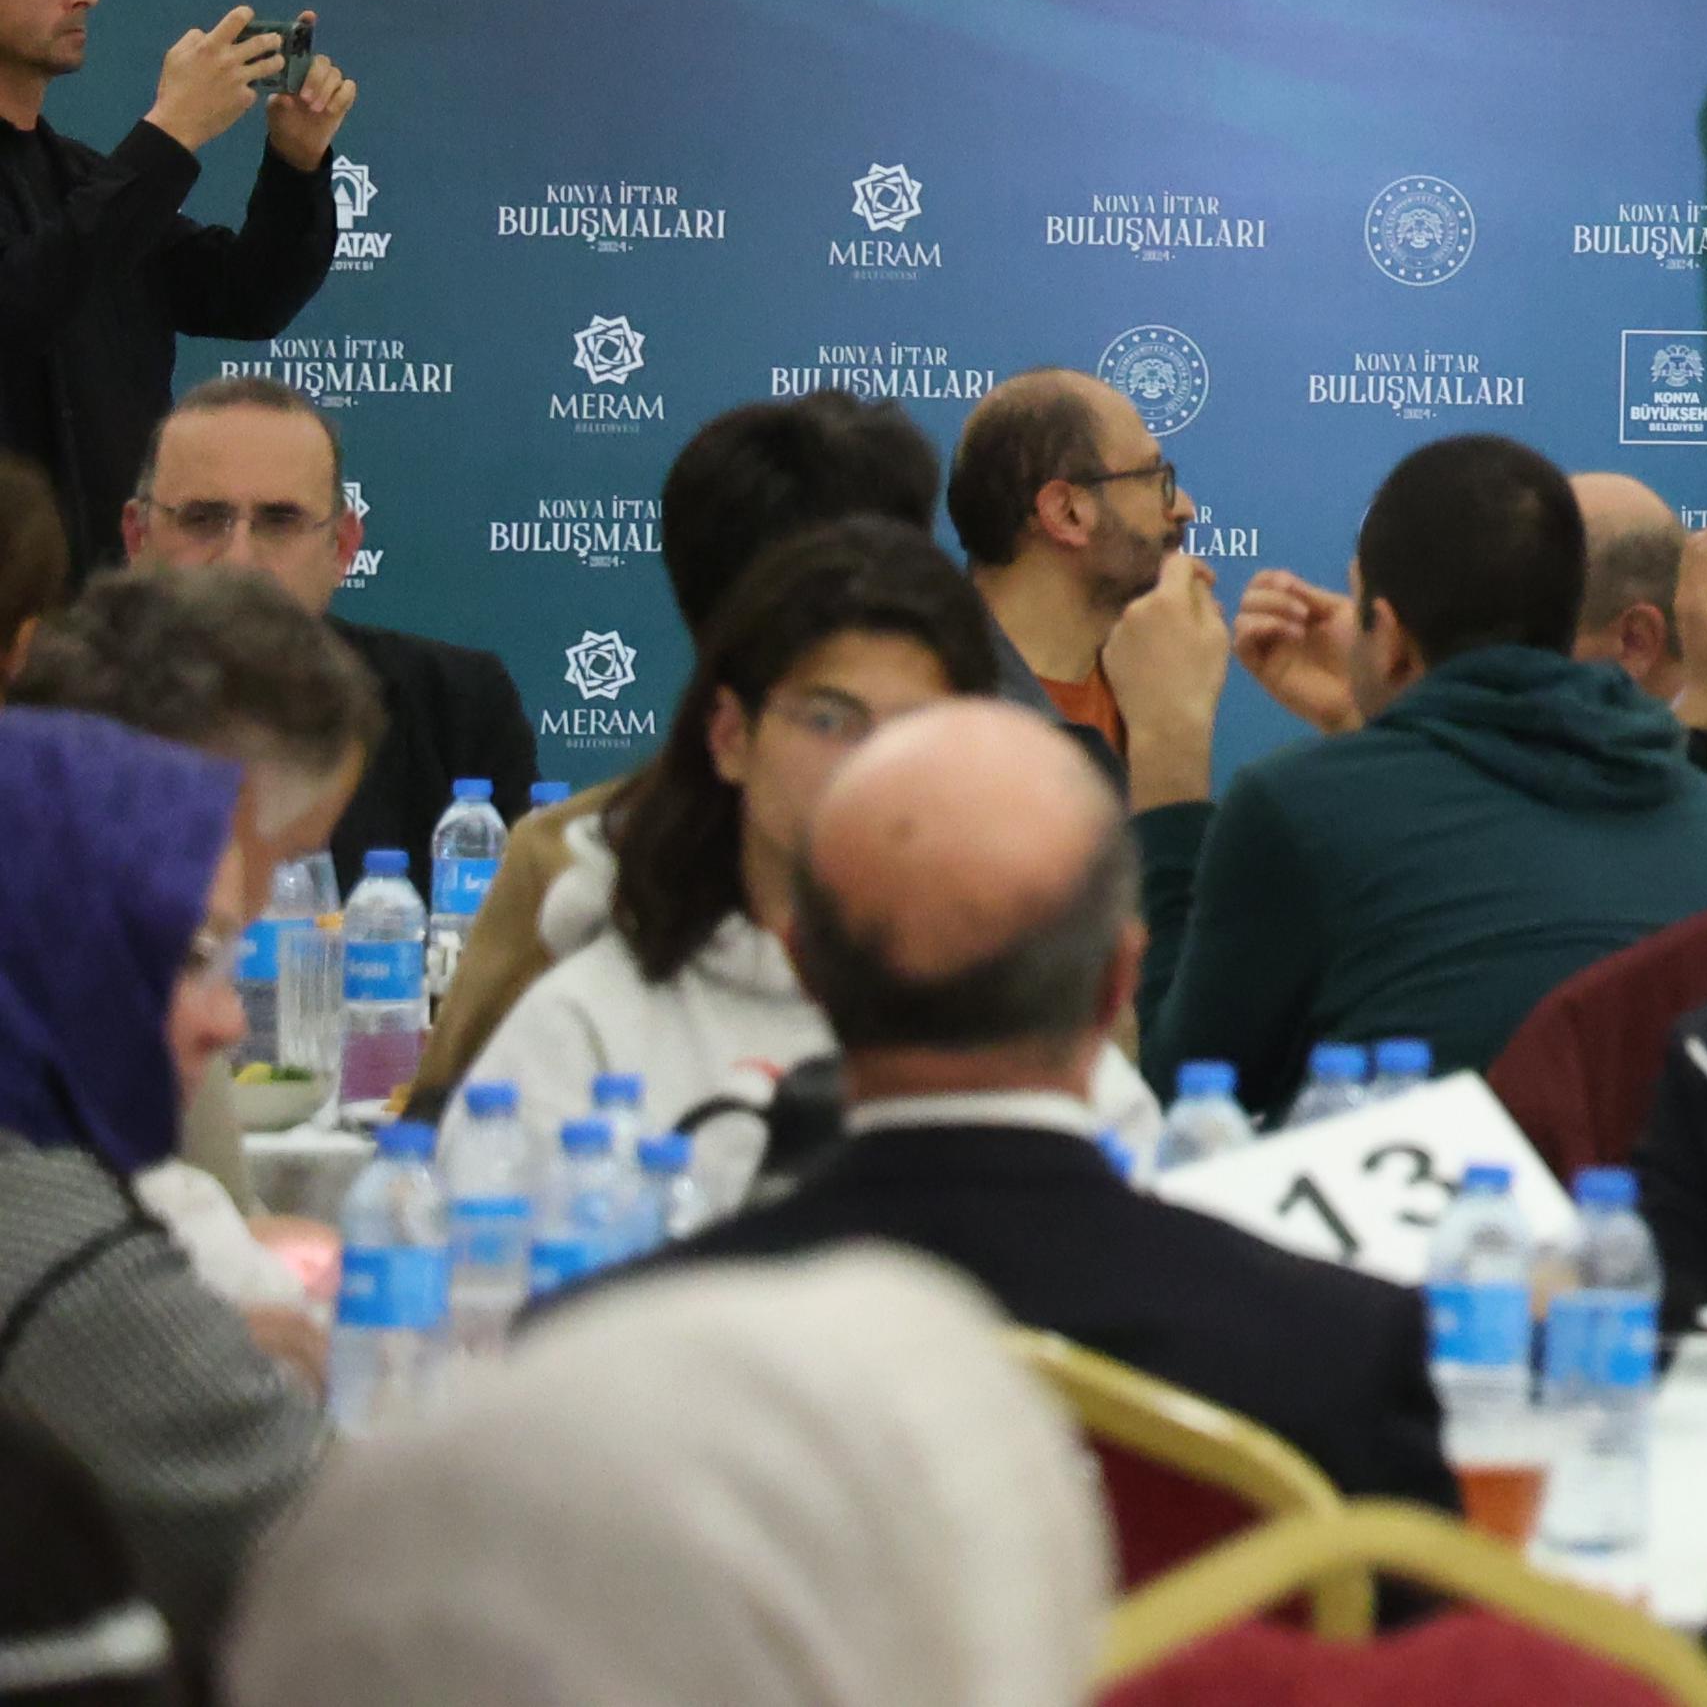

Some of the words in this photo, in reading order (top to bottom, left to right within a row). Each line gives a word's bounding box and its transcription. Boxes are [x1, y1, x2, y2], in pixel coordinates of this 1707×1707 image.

[547, 184, 613, 205] KONYA
[620, 180, 678, 205] İFTAR
[1093, 194, 1156, 214] KONYA
[1163, 190, 1220, 215] İFTAR
[498, 206, 726, 243] BULUŞMALARI
[1619, 204, 1680, 223] KONYA
[334, 233, 391, 258] ATAY
[1046, 216, 1265, 252] BULUŞMALARI
[829, 240, 942, 267] MERAM
[270, 339, 337, 359] KONYA
[345, 334, 404, 360] İFTAR
[819, 345, 883, 365] KONYA
[890, 341, 948, 366] İFTAR
[1355, 353, 1417, 372] KONYA
[1424, 349, 1479, 373] İFTAR
[1309, 374, 1524, 411] BULUŞMALARI
[1654, 391, 1700, 404] KONYA
[549, 393, 664, 420] MERAM
[539, 499, 604, 519] KONYA
[612, 495, 663, 520] İFTA
[490, 521, 661, 558] BULUŞMAL
[540, 708, 656, 735] MERAM
[1276, 1140, 1462, 1258] 13
